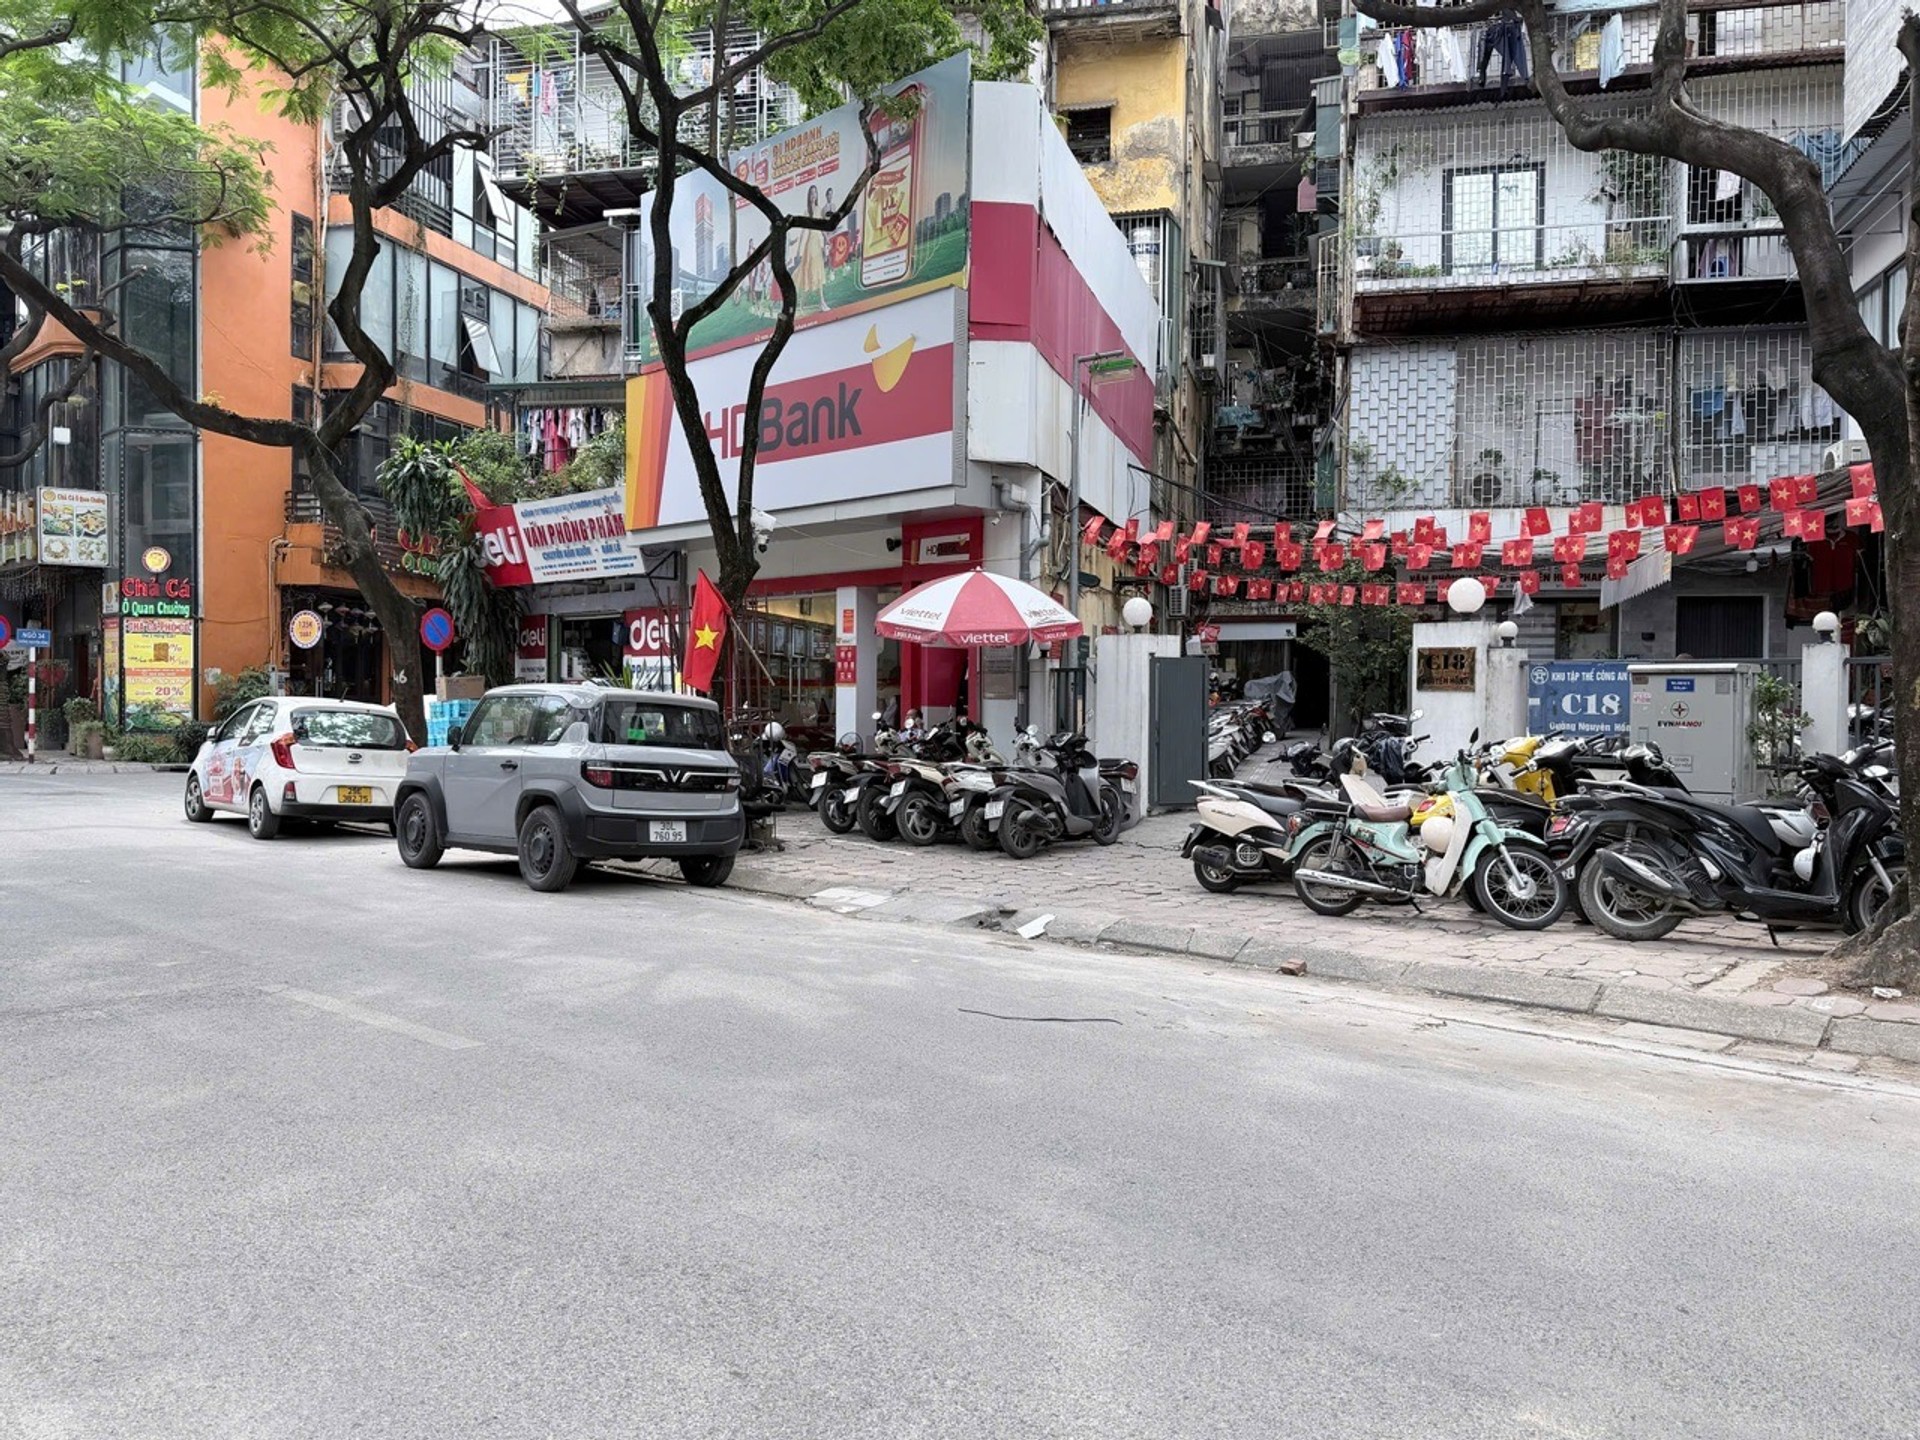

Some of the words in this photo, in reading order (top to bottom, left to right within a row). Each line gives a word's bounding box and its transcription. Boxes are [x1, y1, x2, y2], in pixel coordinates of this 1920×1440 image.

[705, 382, 863, 459] HDBank
[523, 521, 548, 547] VĂN
[547, 516, 589, 545] PHÒNG
[588, 504, 626, 540] PHẨM
[474, 526, 524, 567] eli
[122, 577, 160, 597] Chả
[165, 578, 191, 598] Cá
[122, 598, 129, 613] Ô
[131, 602, 154, 617] Quan
[900, 607, 942, 620] viettel
[520, 628, 545, 647] deli
[960, 632, 1010, 644] viettel
[1426, 653, 1465, 670] C18
[1551, 671, 1565, 681] KHU
[1567, 671, 1580, 682] TẬP
[1581, 667, 1595, 681] THẾ
[1596, 669, 1616, 681] CÔNG
[1617, 671, 1628, 681] AN
[1561, 692, 1621, 716] C18
[1614, 722, 1632, 732] Hồn
